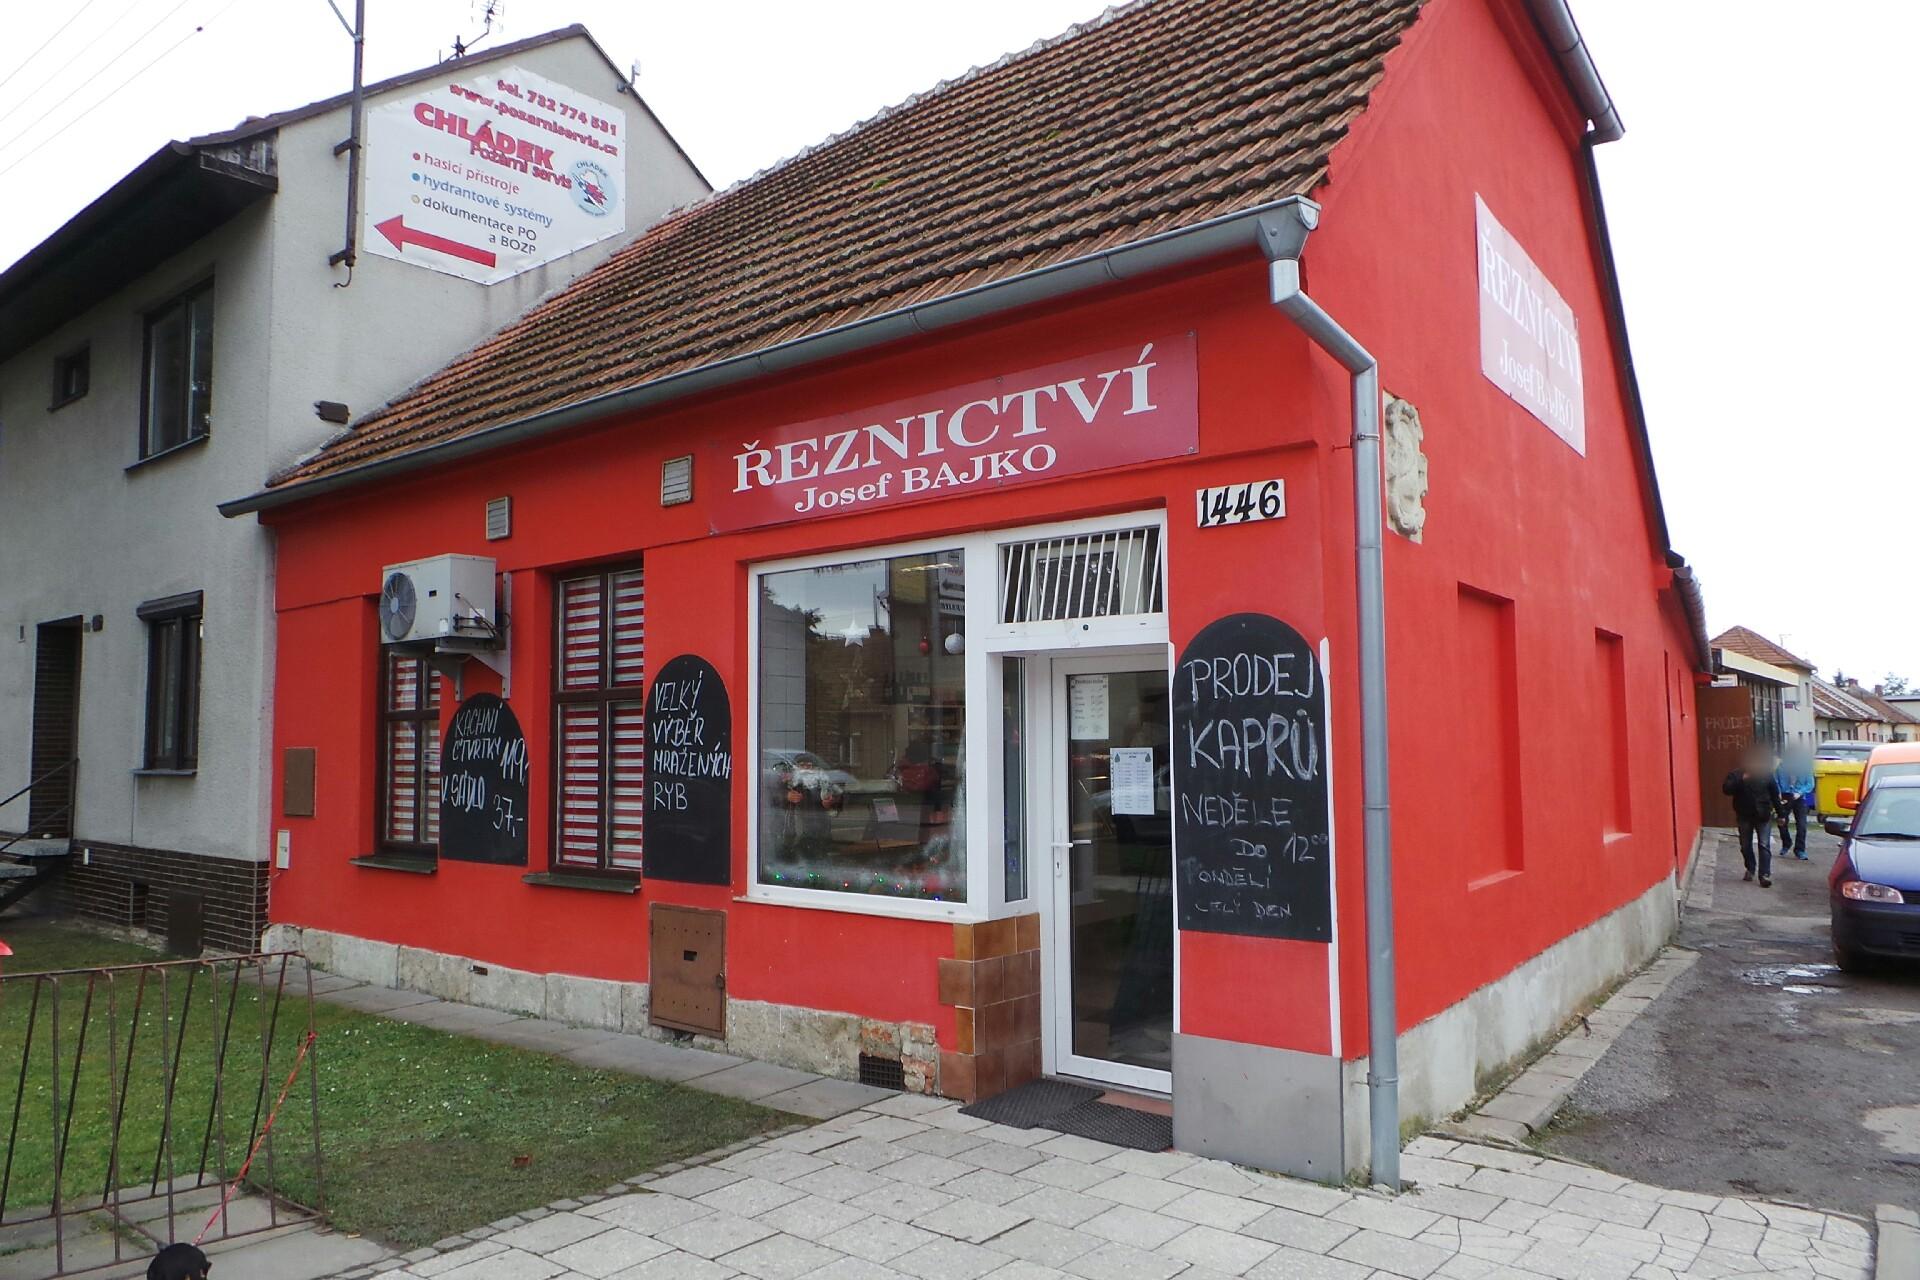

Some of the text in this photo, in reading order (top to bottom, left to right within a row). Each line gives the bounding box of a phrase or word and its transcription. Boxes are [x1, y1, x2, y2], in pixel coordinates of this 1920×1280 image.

[497, 79, 523, 99] tel.
[560, 102, 588, 125] 774
[414, 102, 554, 170] CHLÁDEK
[466, 168, 520, 195] přístroje
[532, 165, 572, 190] servis
[423, 174, 501, 209] hydrantové
[504, 200, 553, 228] systémy
[423, 197, 537, 241] dokumentace PO
[489, 233, 536, 255] a BOZP
[1500, 338, 1534, 396] Josef
[732, 343, 1158, 493] ŘEZNICTVÍ
[795, 444, 1057, 512] Josef BAJKO
[1200, 481, 1281, 528] 1446
[655, 670, 703, 713] VELKÝ
[1183, 651, 1313, 702] PRODEJ
[455, 702, 503, 738] KACHNÍ
[653, 710, 705, 747] VÝBĚR
[452, 736, 502, 762] ČTVRTKY
[653, 741, 732, 779] MRAŽENÝCH
[1188, 708, 1318, 780] KAPRŮ
[653, 781, 688, 811] RYB
[1182, 790, 1293, 828] NEDĚLE
[1253, 901, 1292, 920] DEN
